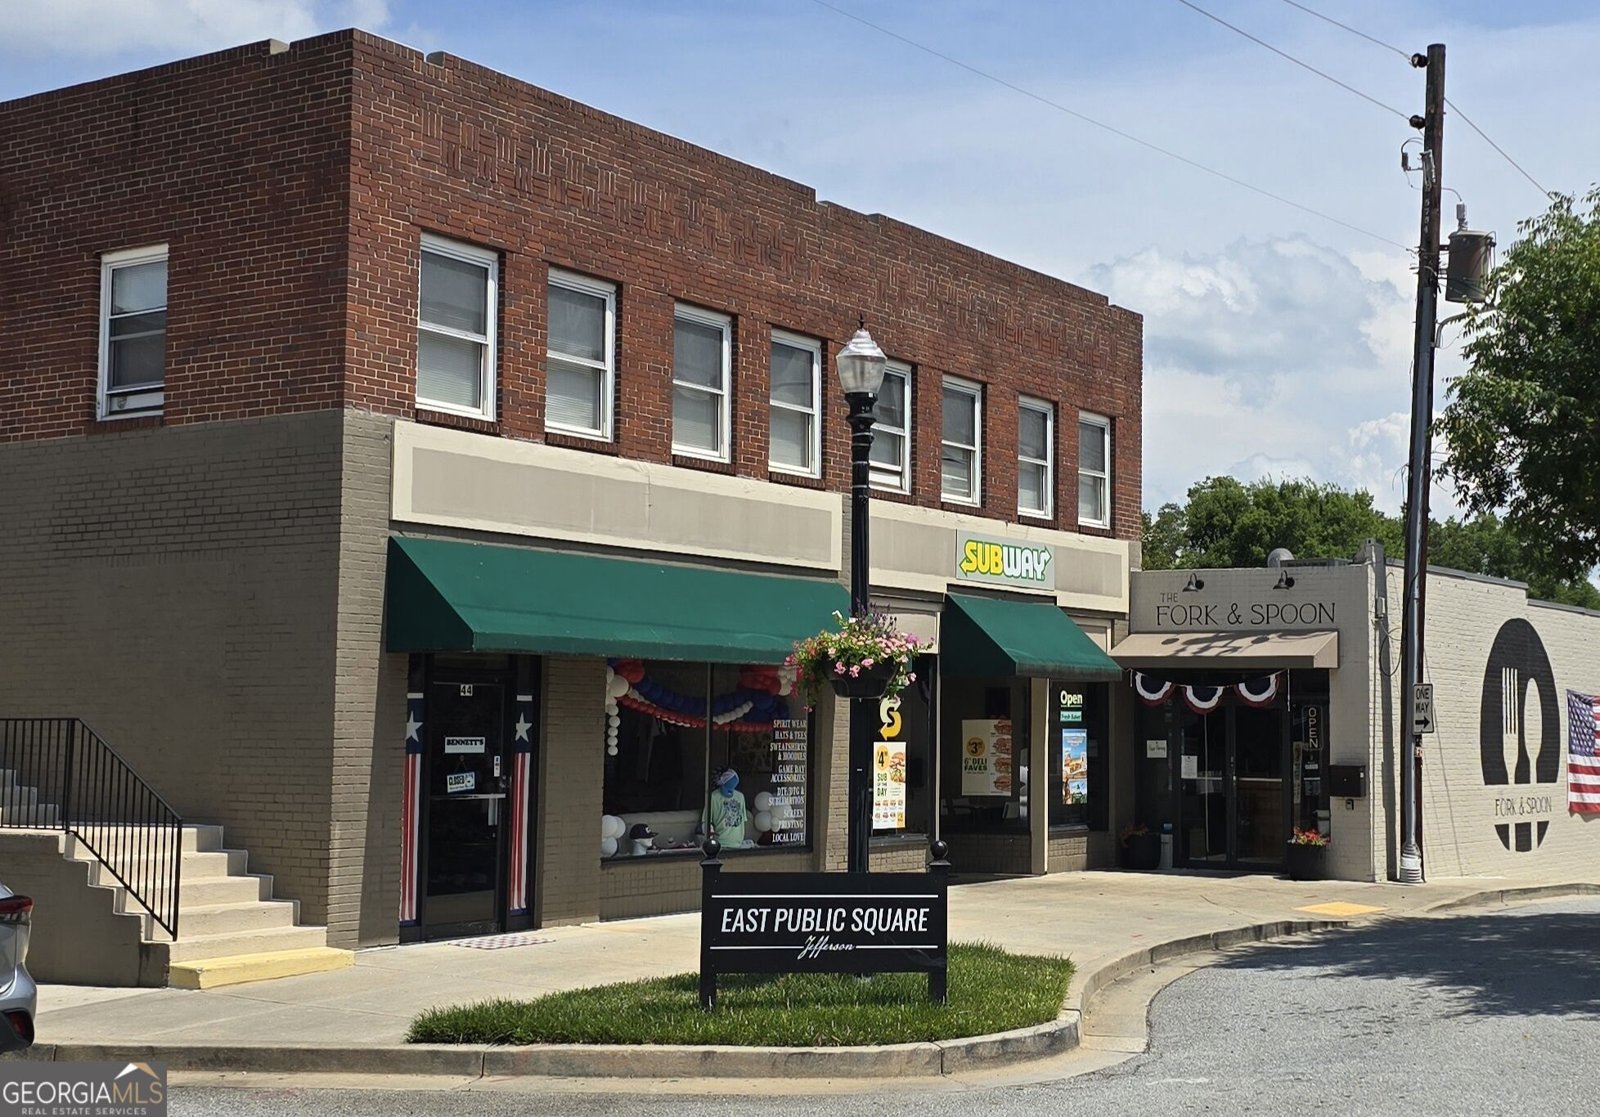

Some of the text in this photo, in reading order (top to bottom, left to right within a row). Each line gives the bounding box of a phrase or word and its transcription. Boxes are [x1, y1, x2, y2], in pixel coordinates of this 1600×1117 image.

[959, 539, 1052, 581] SUBWAY
[1160, 592, 1178, 603] THE
[1156, 602, 1336, 626] FORK & SPOON
[461, 684, 473, 696] 44
[1415, 687, 1430, 700] ONE
[1060, 690, 1083, 707] Open
[1415, 702, 1430, 713] WAY
[1308, 707, 1319, 748] OPEN
[775, 730, 789, 740] HATS
[794, 730, 807, 740] TEES
[446, 738, 484, 746] BENNETT'S
[778, 764, 805, 774] GAME DAY
[877, 787, 888, 797] DAY
[1495, 796, 1552, 816] FORK & SPOON
[772, 832, 804, 843] LOCAL LOVE
[721, 907, 930, 935] EAST PUBLIC SQUARE
[797, 935, 855, 959] Jefferson
